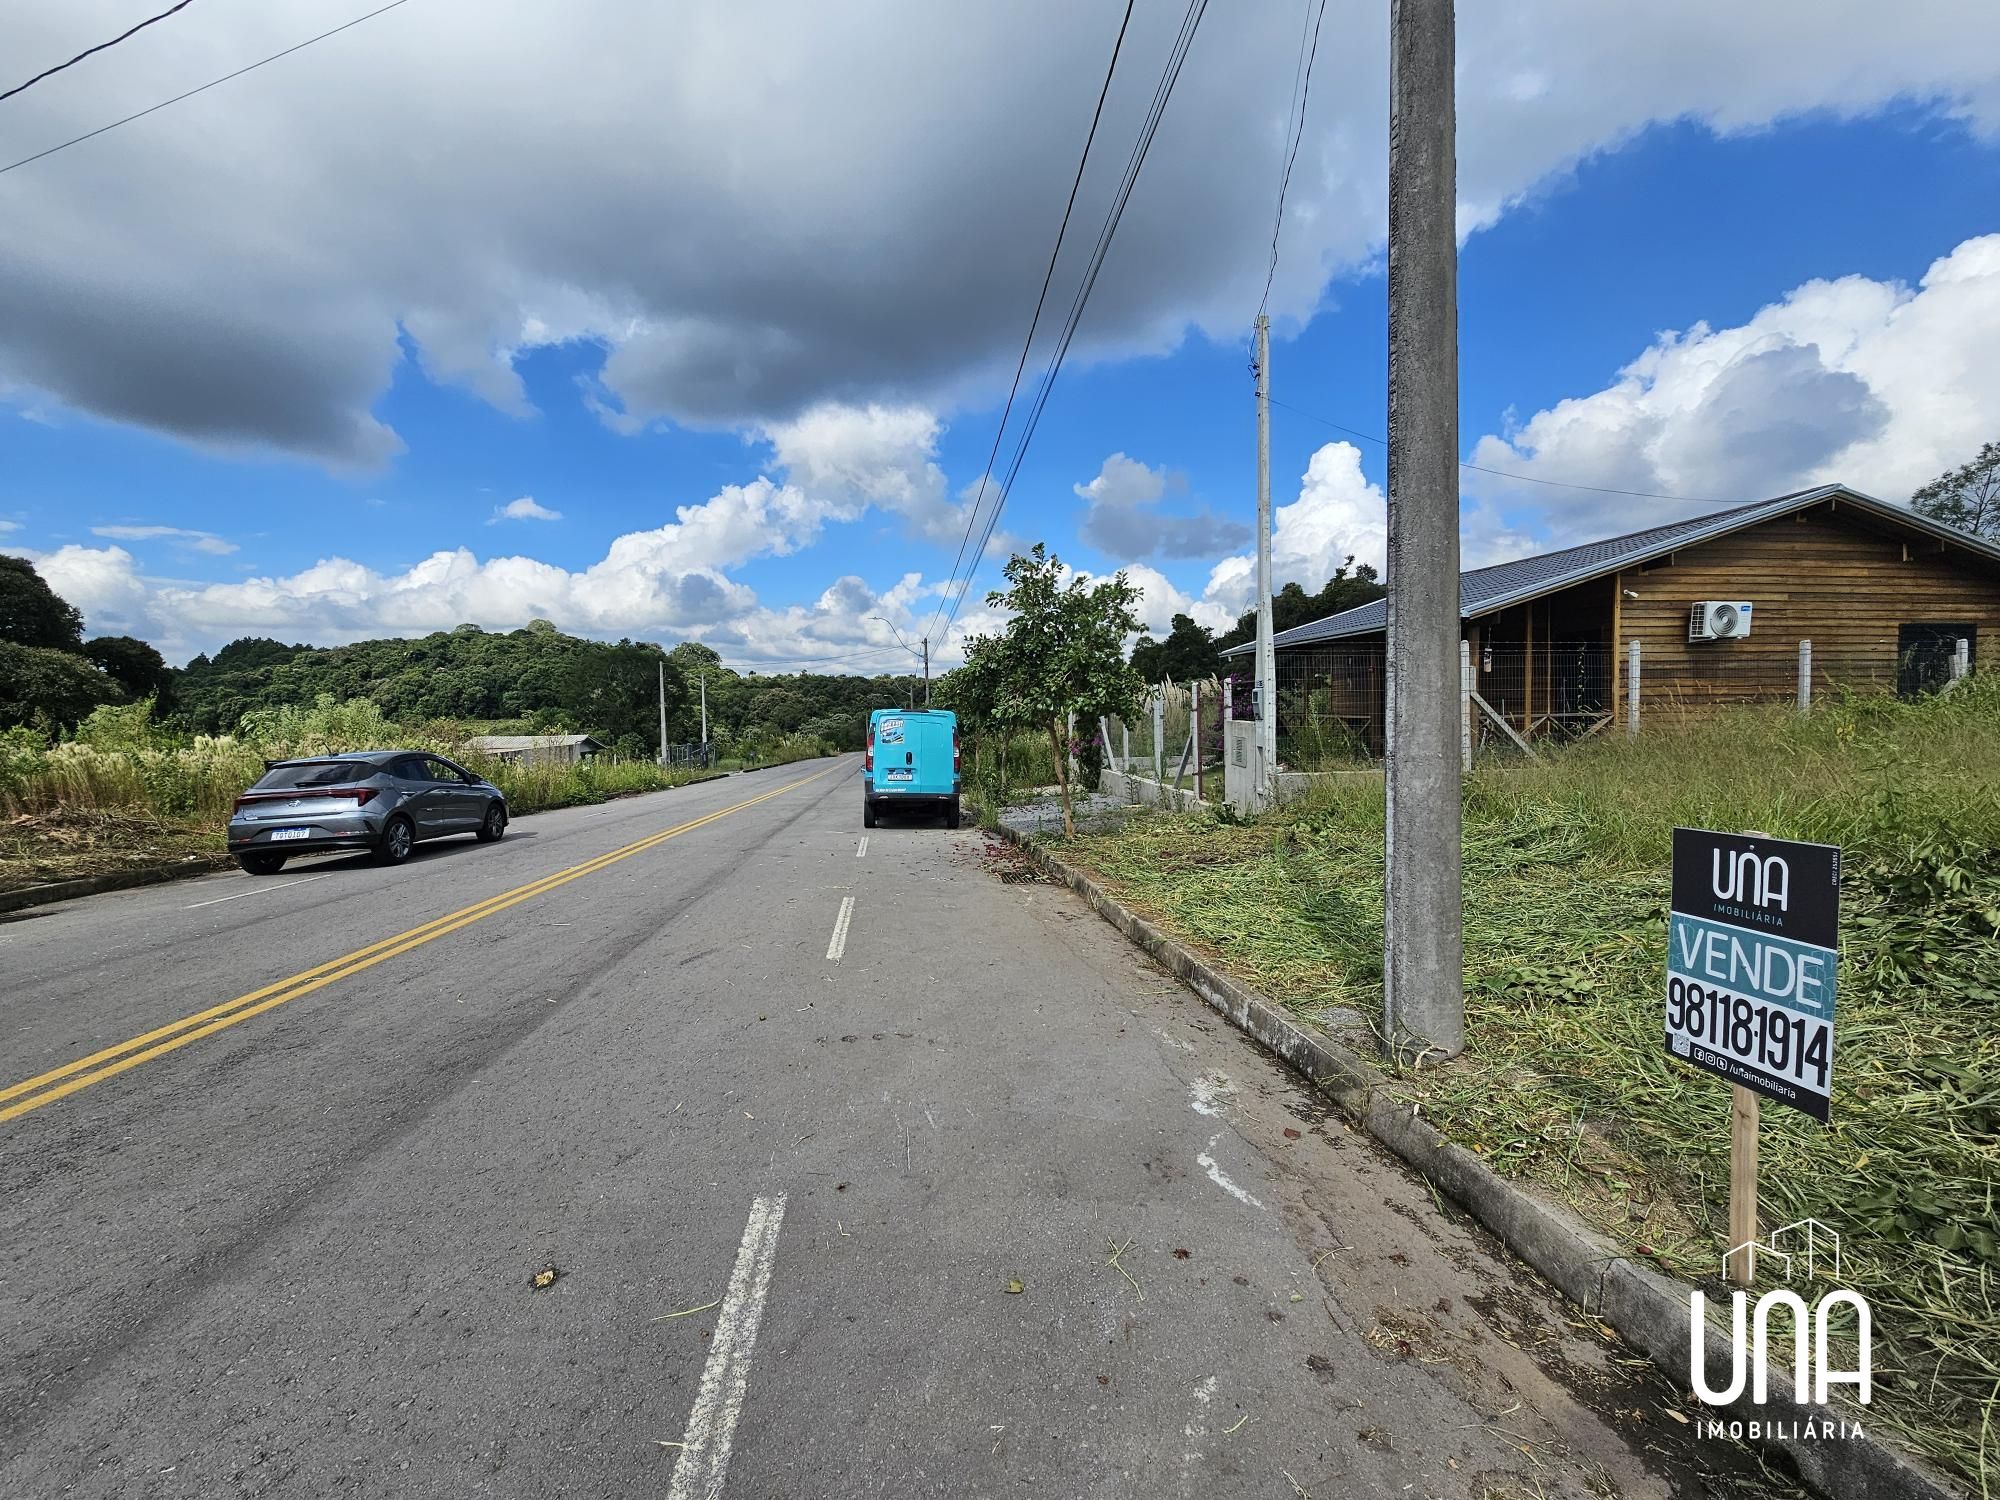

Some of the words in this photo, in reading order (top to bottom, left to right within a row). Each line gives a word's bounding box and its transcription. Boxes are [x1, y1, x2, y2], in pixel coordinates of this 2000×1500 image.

[1712, 847, 1789, 912] UNA
[1713, 903, 1784, 928] IMOBILIÁRIA
[1678, 923, 1825, 1009] VENDE
